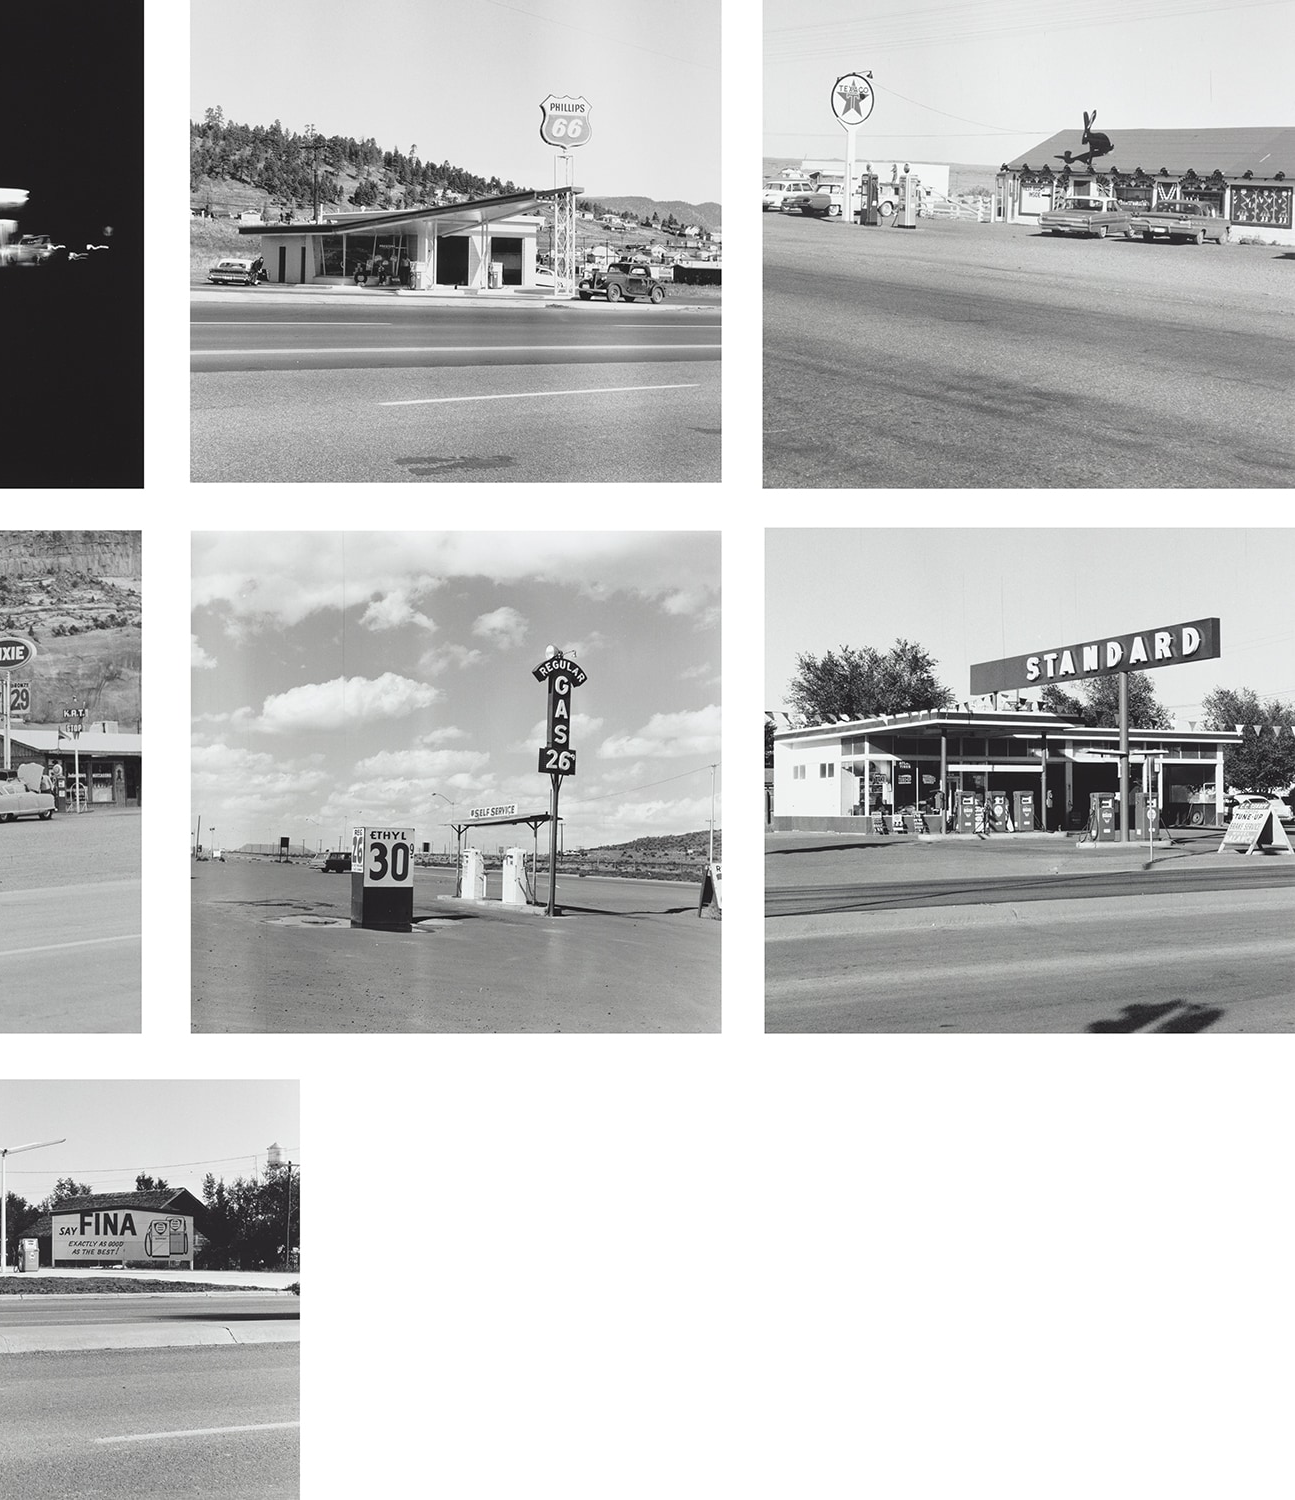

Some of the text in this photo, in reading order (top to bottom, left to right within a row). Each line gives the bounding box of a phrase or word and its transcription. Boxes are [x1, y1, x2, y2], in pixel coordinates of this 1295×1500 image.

[839, 84, 869, 94] TEXACO
[550, 102, 585, 113] PHILLIPS
[552, 118, 583, 138] 66
[1026, 627, 1202, 682] STANDARD
[539, 660, 586, 682] REGULAR
[10, 689, 30, 711] 29
[554, 675, 570, 744] GAS
[66, 724, 83, 733] STOP
[475, 808, 490, 817] SELF
[490, 805, 515, 816] SERVICE
[370, 831, 407, 840] ETHYL
[353, 836, 363, 864] 26
[369, 842, 410, 882] 30
[59, 1226, 78, 1236] SAY
[79, 1212, 137, 1236] FINA
[97, 1247, 120, 1256] BEST!
